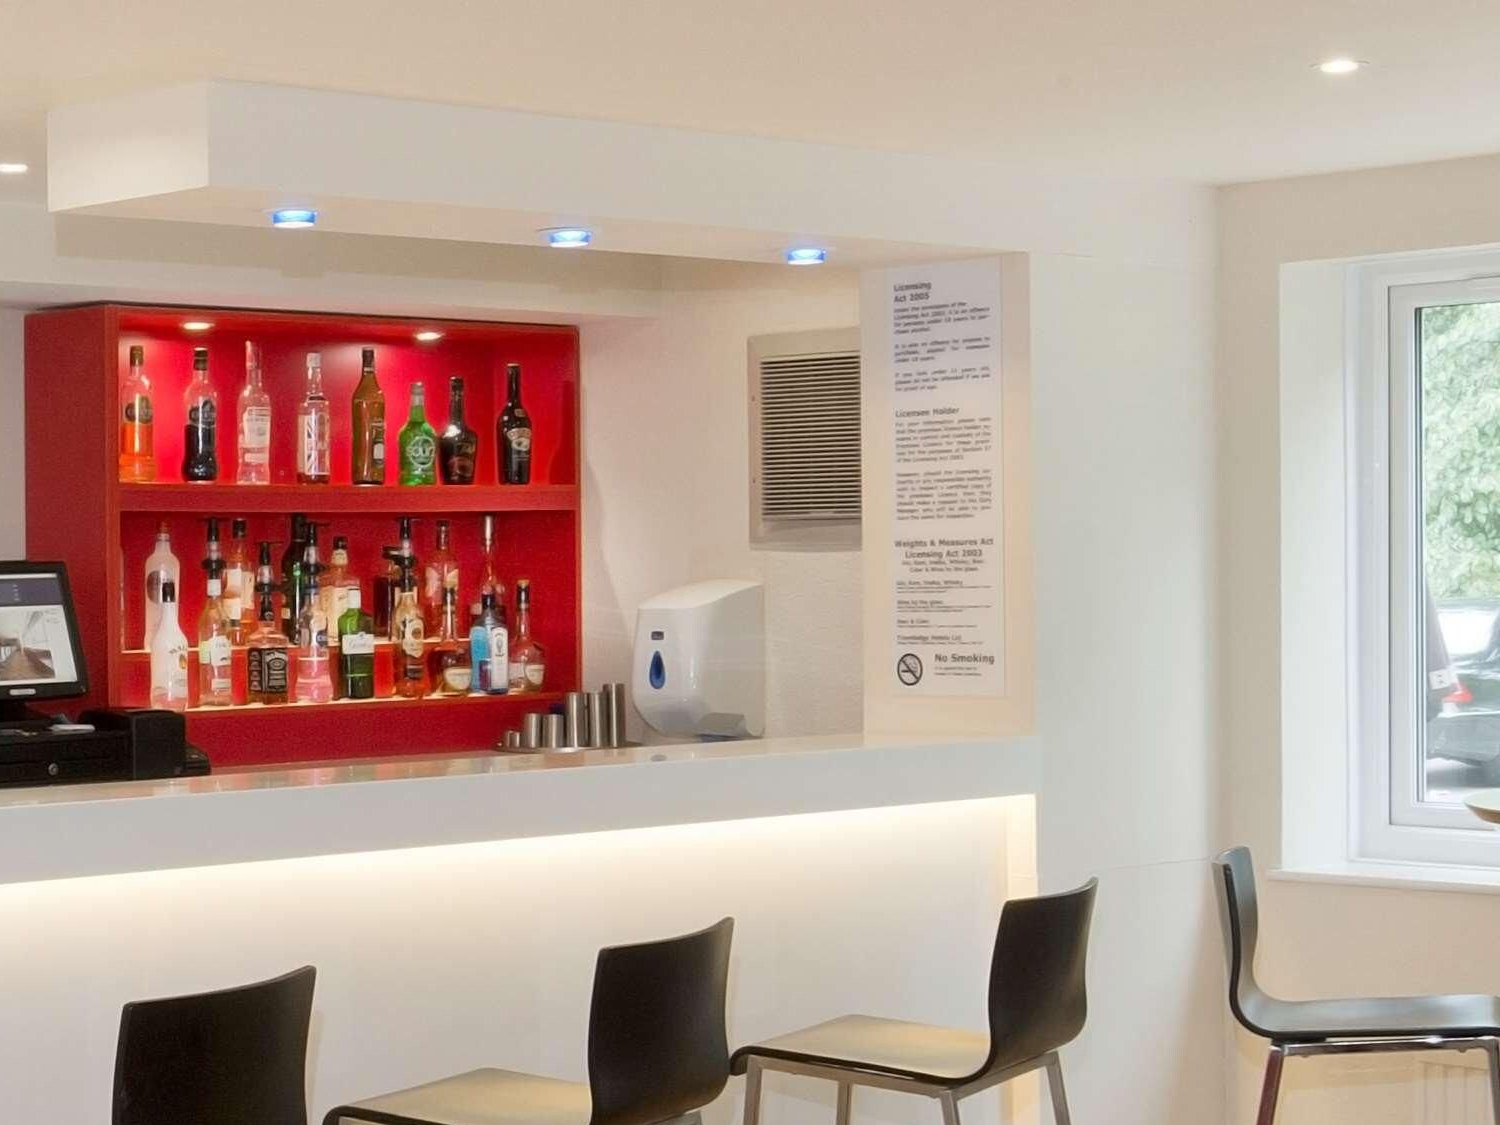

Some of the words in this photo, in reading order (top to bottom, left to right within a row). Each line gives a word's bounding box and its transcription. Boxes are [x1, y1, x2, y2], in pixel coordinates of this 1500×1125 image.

[893, 294, 907, 303] Act
[894, 539, 927, 549] Weights
[929, 538, 937, 547] &
[938, 538, 979, 547] Measures
[980, 537, 994, 546] Act
[904, 549, 943, 560] Licensing
[945, 549, 959, 558] Act
[934, 653, 948, 663] No
[950, 652, 995, 665] Smoking
